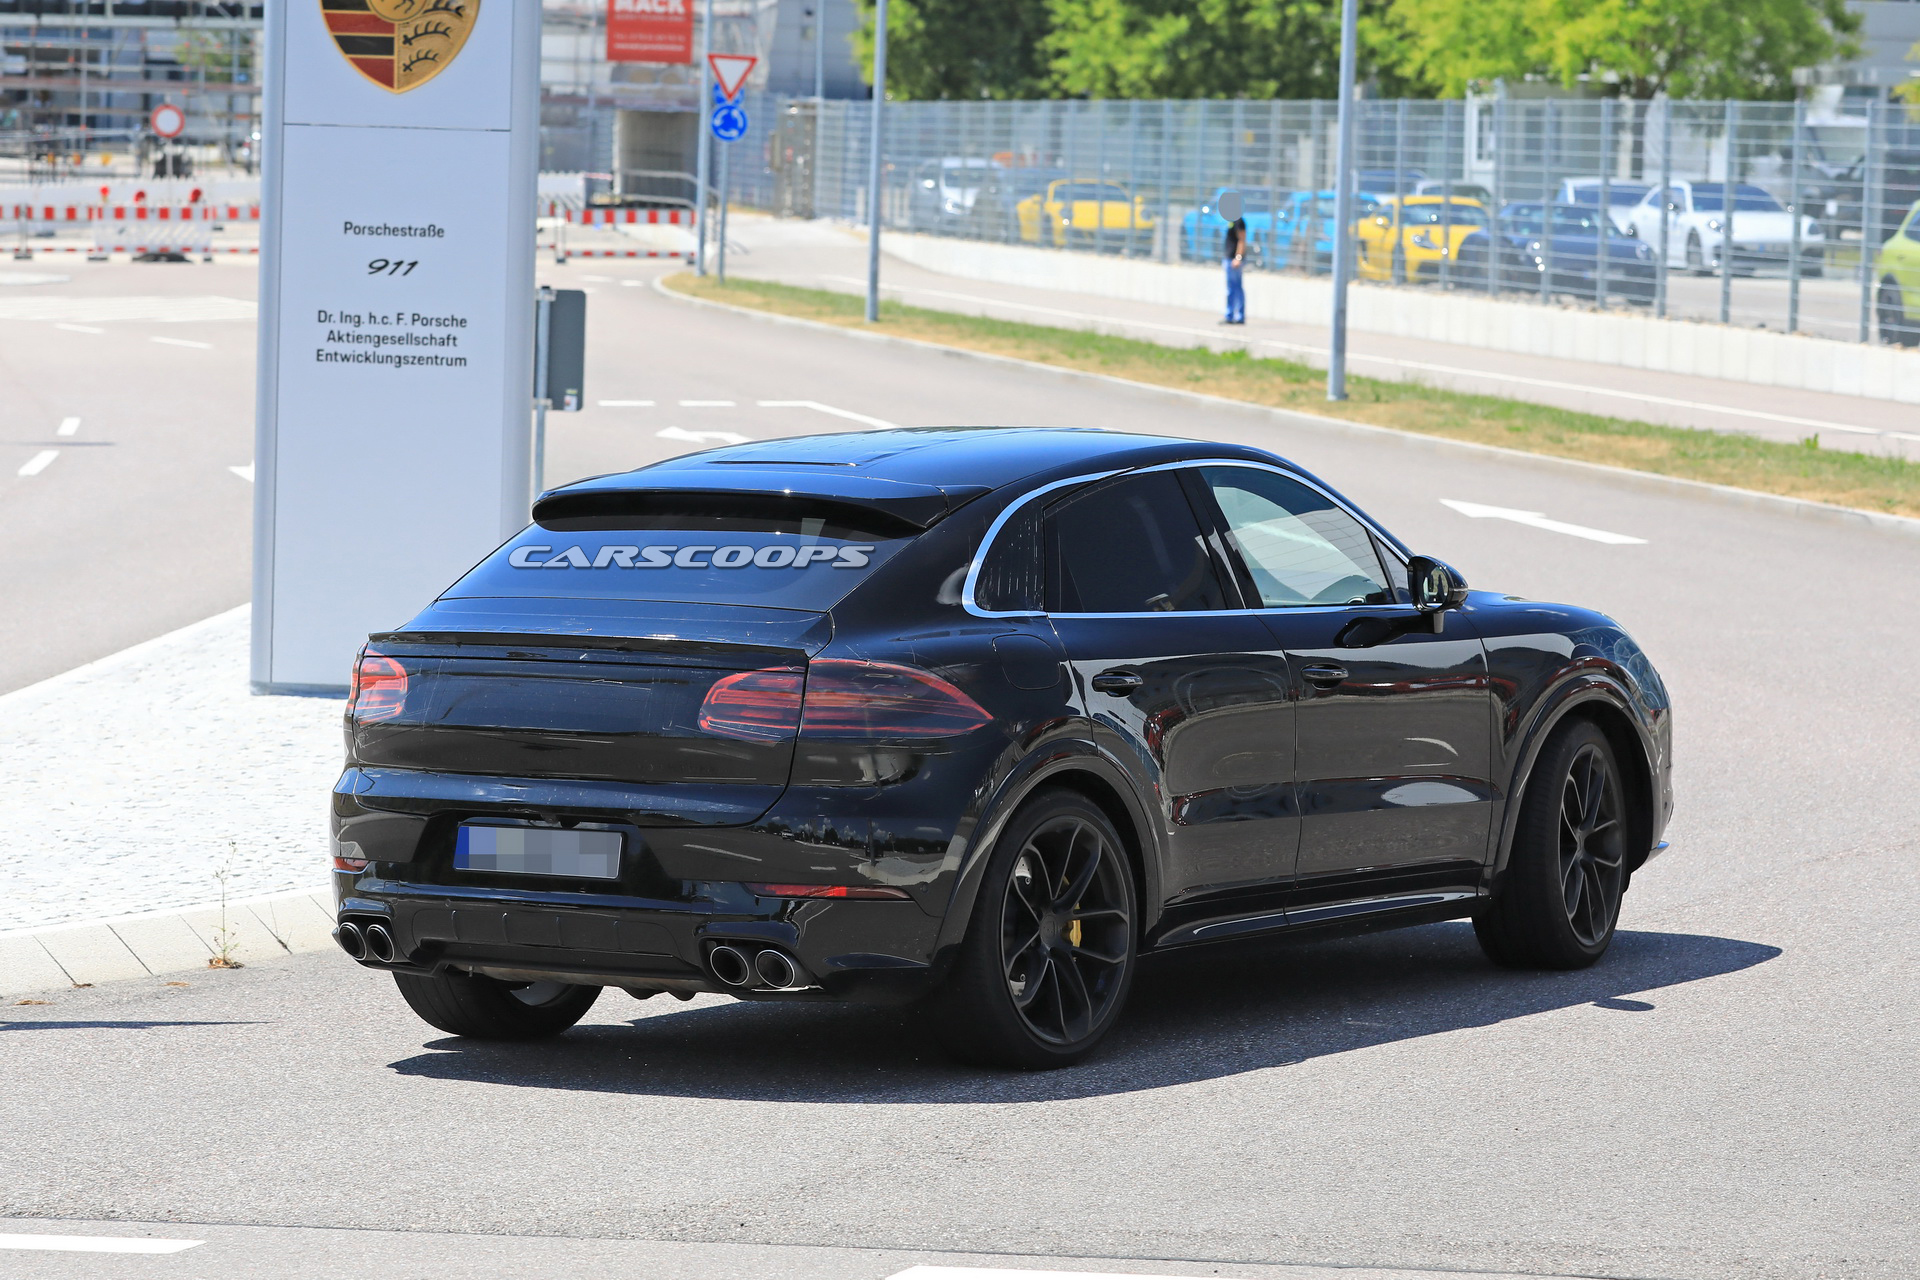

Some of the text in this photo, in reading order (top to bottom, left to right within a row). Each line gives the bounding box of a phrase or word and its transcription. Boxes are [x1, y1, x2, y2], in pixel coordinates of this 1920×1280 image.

[344, 221, 445, 238] Porschestraße
[368, 258, 419, 276] 911
[317, 309, 468, 328] Dr. Ing. h.c. F. Porsche
[326, 330, 458, 348] Aktiengesellschaft
[316, 349, 467, 369] Entwicklungszentrum
